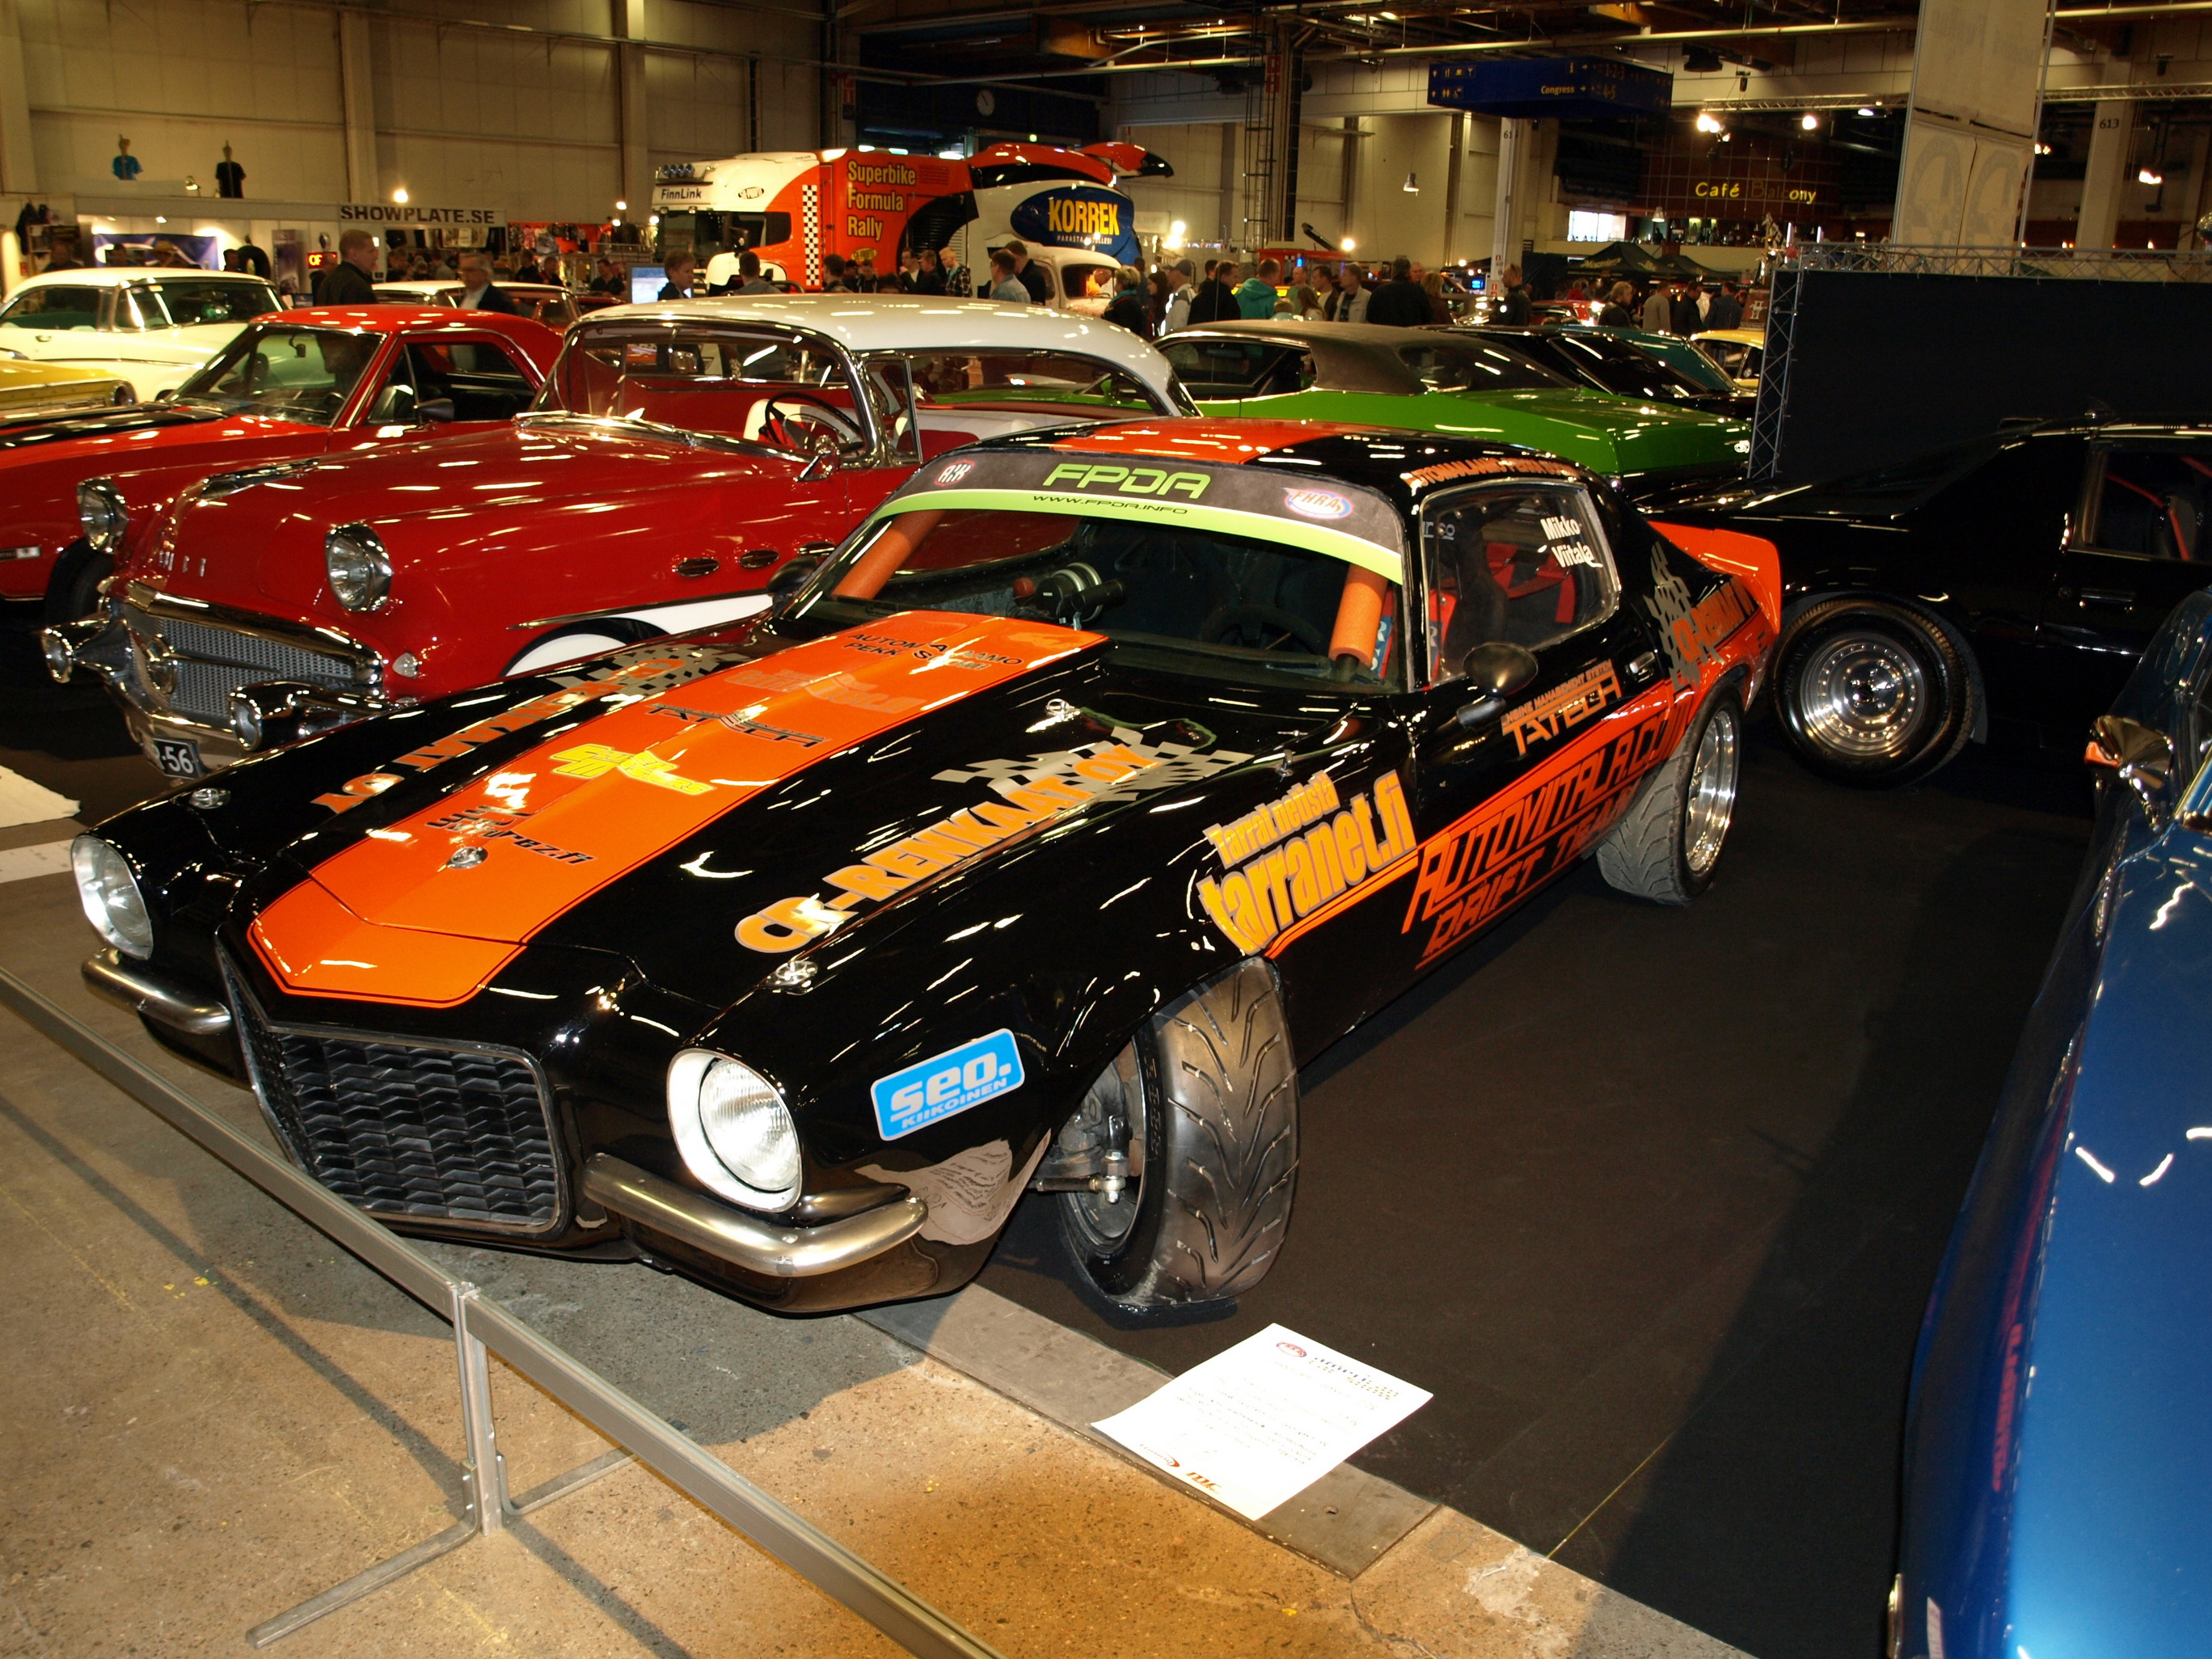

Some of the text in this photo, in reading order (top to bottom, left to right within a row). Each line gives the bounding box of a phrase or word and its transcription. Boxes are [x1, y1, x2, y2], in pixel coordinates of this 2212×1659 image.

[1541, 85, 1576, 95] Congress
[2100, 118, 2120, 129] 613
[846, 160, 916, 187] Superbike
[661, 188, 703, 201] FinnLink
[847, 189, 905, 212] Formula
[1695, 180, 1817, 204] Café Balcony
[340, 205, 496, 224] SHOWPLATE.SE
[1048, 197, 1121, 235] KORREK
[847, 215, 883, 241] Rally
[1043, 463, 1211, 499] FPDA
[1032, 494, 1188, 515] WWW.FPDA.INFO
[1290, 488, 1342, 513] FHRA
[1540, 516, 1581, 541] Mikko
[1551, 542, 1595, 568] Viitala
[844, 642, 992, 671] PEKK SOMI
[158, 742, 193, 775] -56
[1073, 743, 1160, 786] OY
[1202, 770, 1340, 869] Tarrat netistä
[1196, 769, 1417, 955] tarranet.fi
[1422, 851, 1543, 957] DRIFT
[891, 1052, 1012, 1123] seo.
[901, 1077, 1007, 1129] KIIKOINEN
